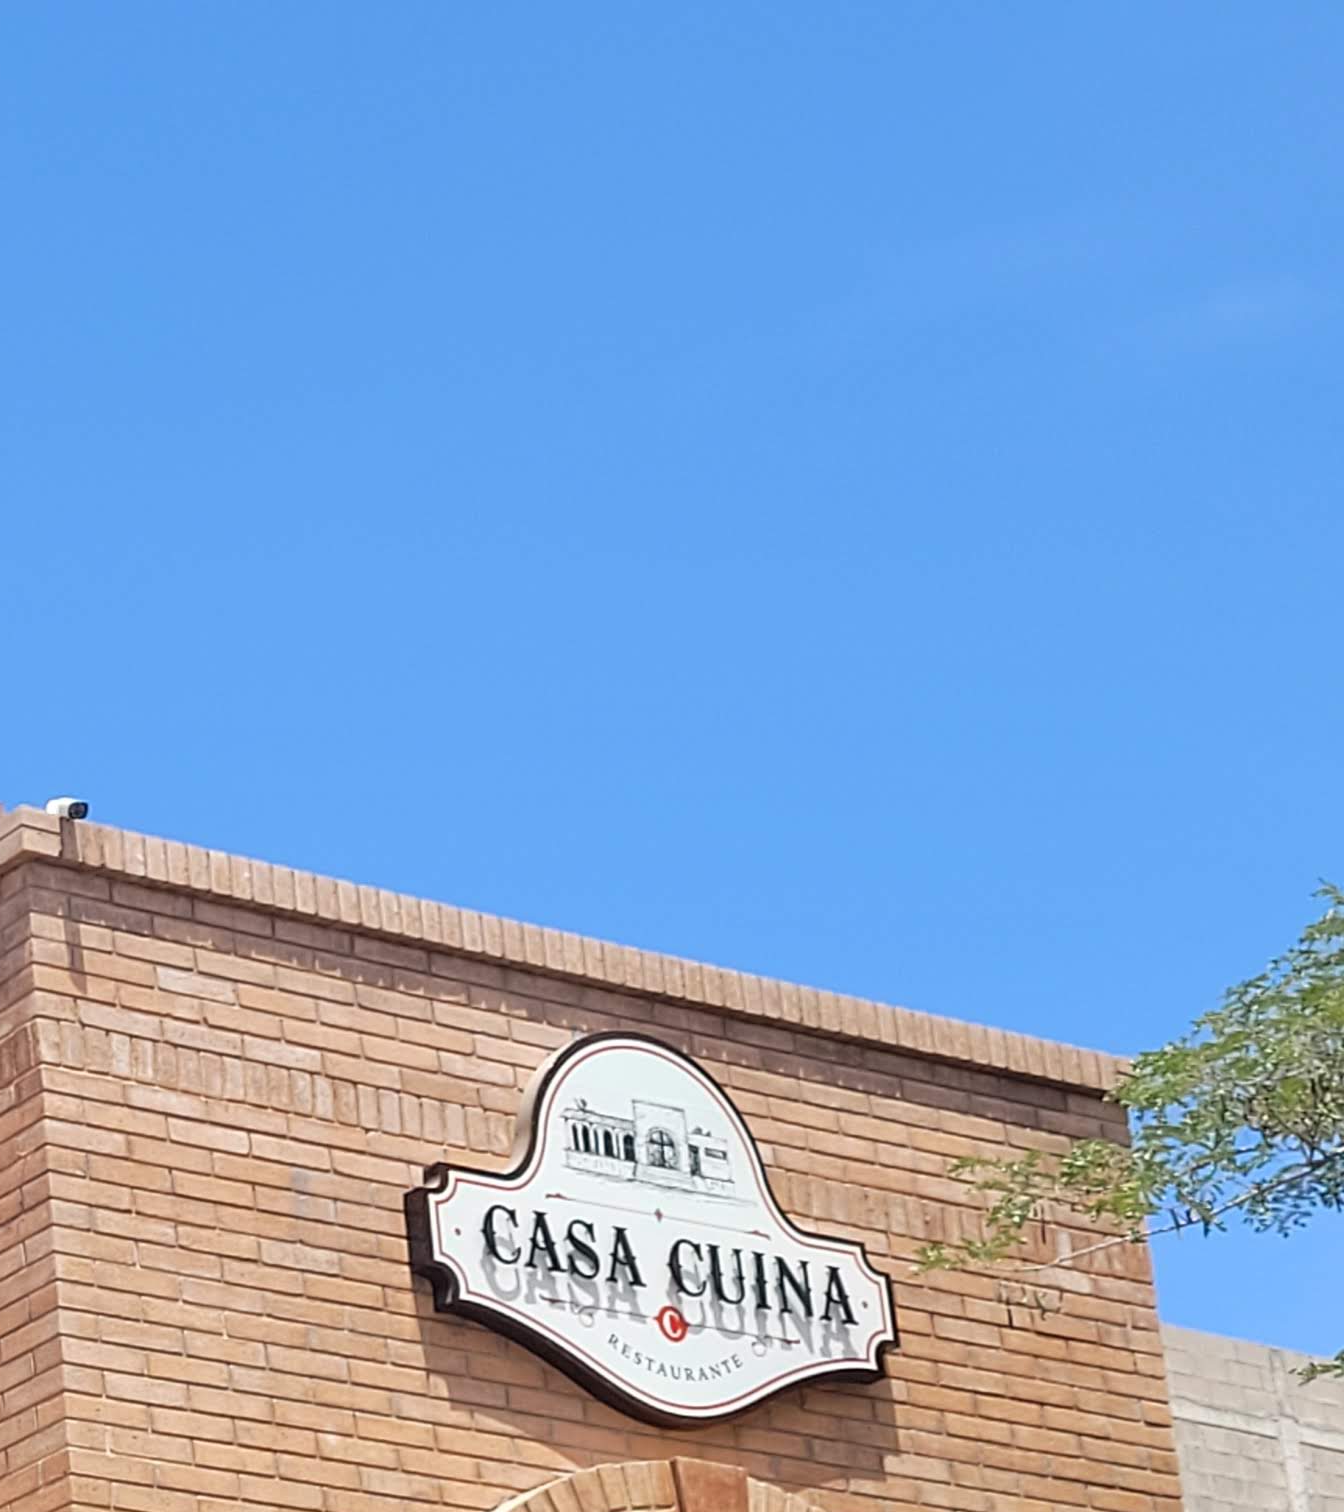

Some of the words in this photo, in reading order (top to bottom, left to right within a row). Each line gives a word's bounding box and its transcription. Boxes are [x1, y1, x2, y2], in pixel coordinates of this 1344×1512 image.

[480, 1204, 647, 1288] CASA
[667, 1239, 859, 1325] CUINA
[661, 1309, 684, 1339] C
[608, 1333, 744, 1381] RESTAURANTE
